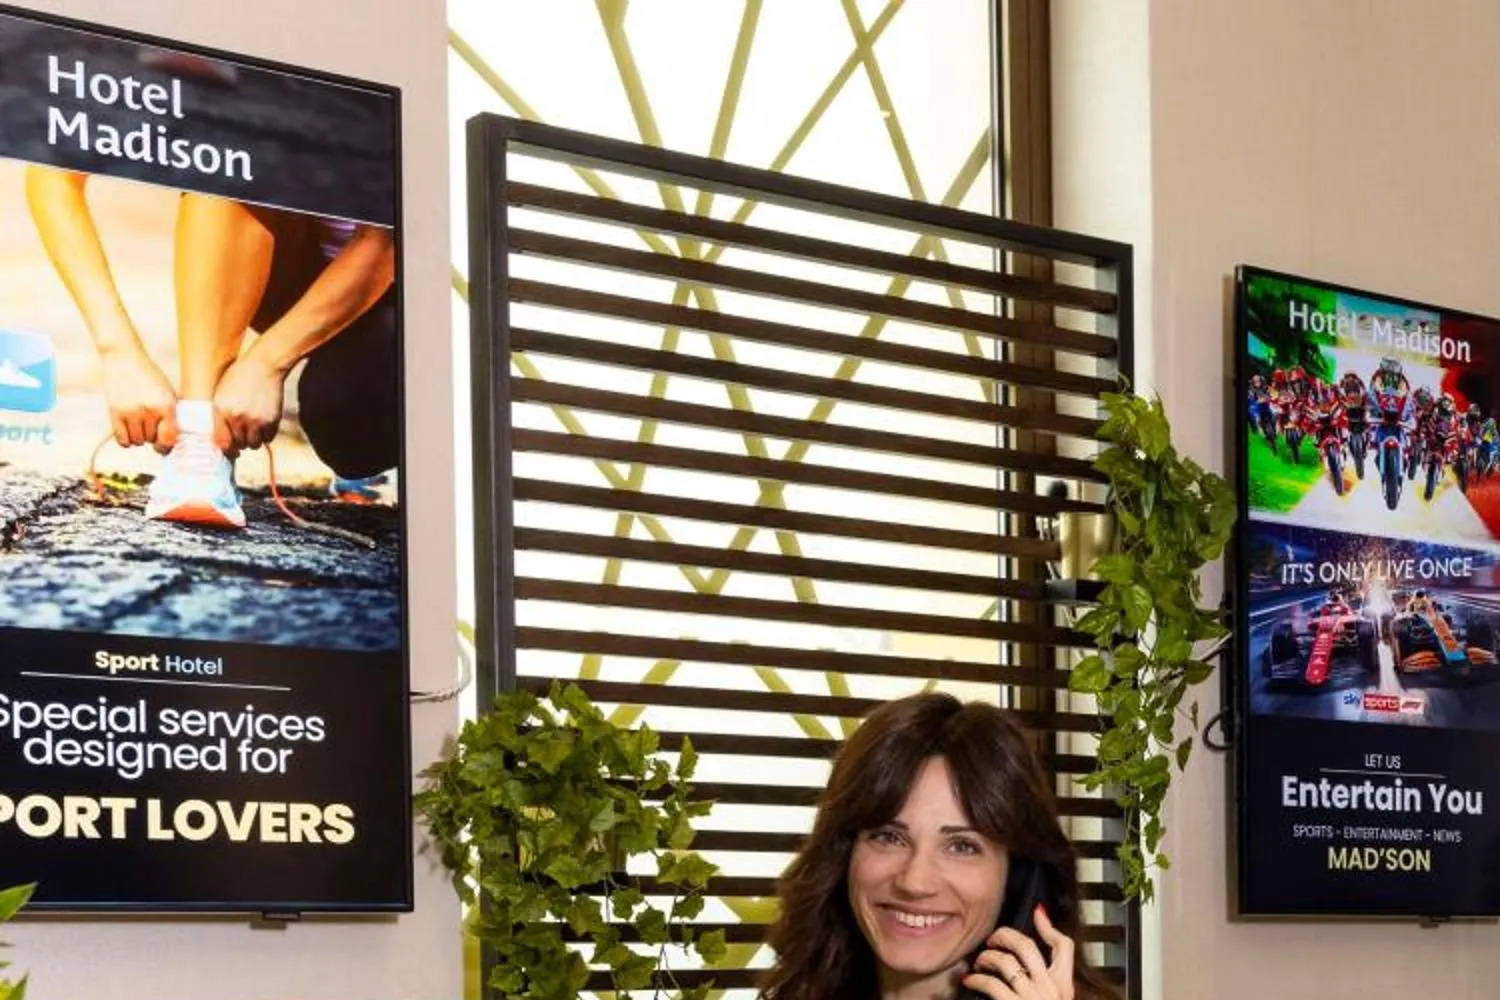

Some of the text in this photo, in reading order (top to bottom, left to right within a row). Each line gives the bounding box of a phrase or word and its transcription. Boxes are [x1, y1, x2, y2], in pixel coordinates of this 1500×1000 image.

[47, 54, 185, 119] Hotel
[47, 106, 254, 181] Madison
[1288, 299, 1472, 363] Hotel Madison
[0, 423, 54, 446] ort
[1281, 556, 1473, 585] IT'S ONLY LIVE ONCE
[95, 650, 224, 676] Sport Hotel
[159, 703, 326, 742] services
[23, 729, 293, 780] designed for
[1364, 753, 1401, 769] LET US
[1282, 775, 1484, 815] Entertain You
[147, 798, 356, 845] LOVERS
[1293, 824, 1334, 839] SPORTS
[1343, 825, 1424, 842] ENTERTAINMENT
[1433, 829, 1463, 844] NEWS
[1327, 846, 1432, 872] MAD'SON
